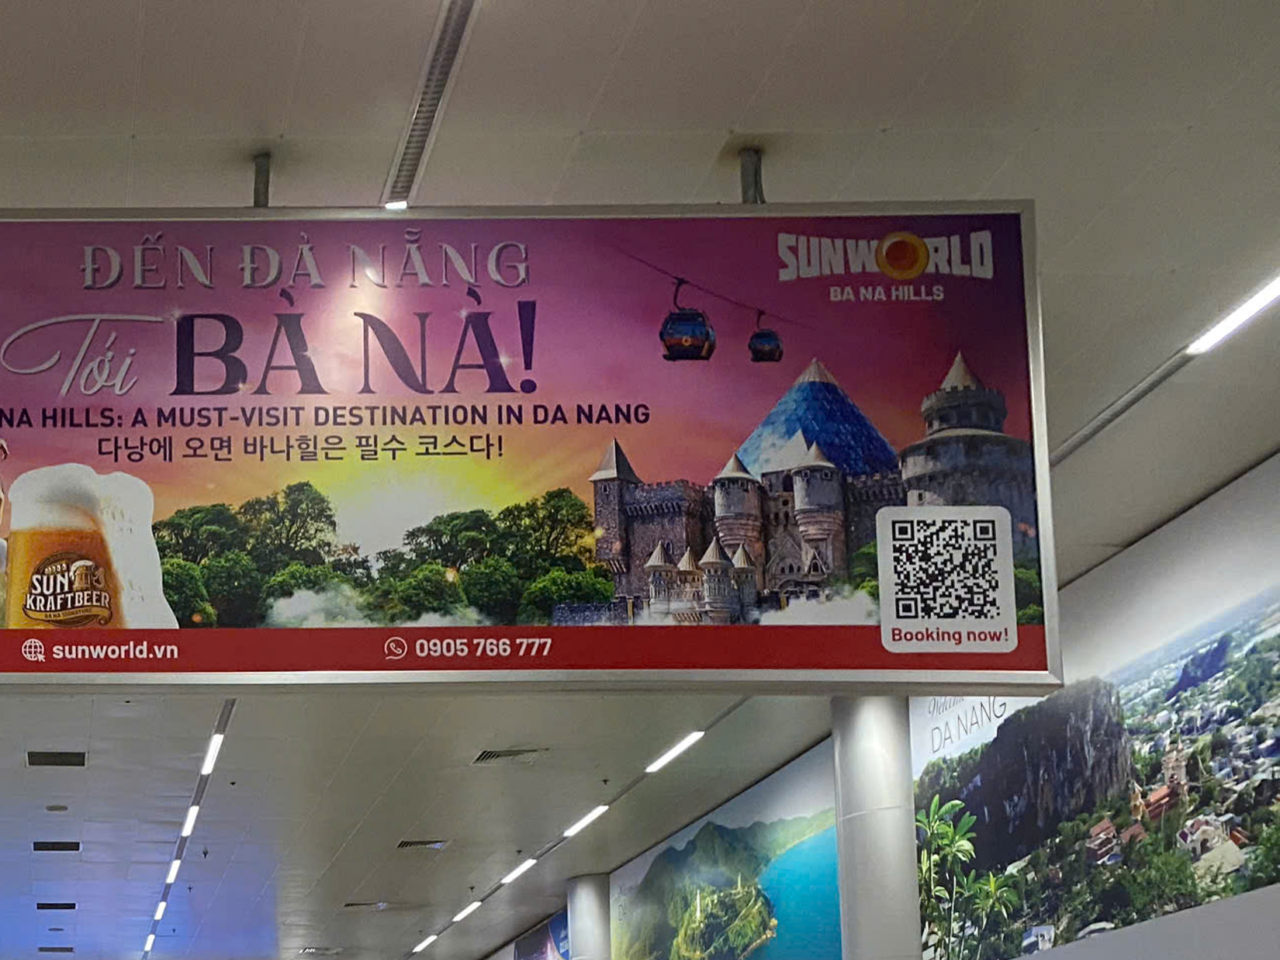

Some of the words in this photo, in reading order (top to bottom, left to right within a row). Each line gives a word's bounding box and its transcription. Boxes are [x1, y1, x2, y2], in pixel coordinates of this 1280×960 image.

[80, 231, 215, 290] ĐẾN
[238, 231, 327, 289] ĐÀ
[349, 228, 531, 288] NẴNG
[830, 286, 855, 301] BA
[859, 286, 886, 301] NA
[891, 285, 945, 301] HILLS
[0, 313, 164, 399] Tới
[169, 287, 330, 396] BÀ
[353, 287, 538, 395] NÀ!
[41, 407, 123, 428] HILLS:
[131, 407, 148, 427] A
[157, 406, 304, 427] MUST-VISIT
[314, 405, 488, 426] DESTINATION
[497, 404, 523, 425] IN
[533, 404, 568, 425] DA
[576, 403, 650, 424] NANG
[97, 435, 173, 462] 다낭에
[182, 435, 233, 462] 오면
[243, 435, 347, 461] 바나힐은
[355, 435, 407, 461] 필수
[415, 434, 504, 460] 코스다!
[31, 573, 70, 595] SUN
[26, 591, 110, 611] KRAFTBEER
[416, 638, 468, 657] 0905
[473, 638, 511, 657] 766
[516, 638, 552, 656] 777
[891, 627, 962, 646] Booking
[967, 627, 1009, 642] now!
[52, 641, 178, 659] sunworld.vn
[931, 721, 954, 754] DA
[957, 696, 1007, 740] NANG
